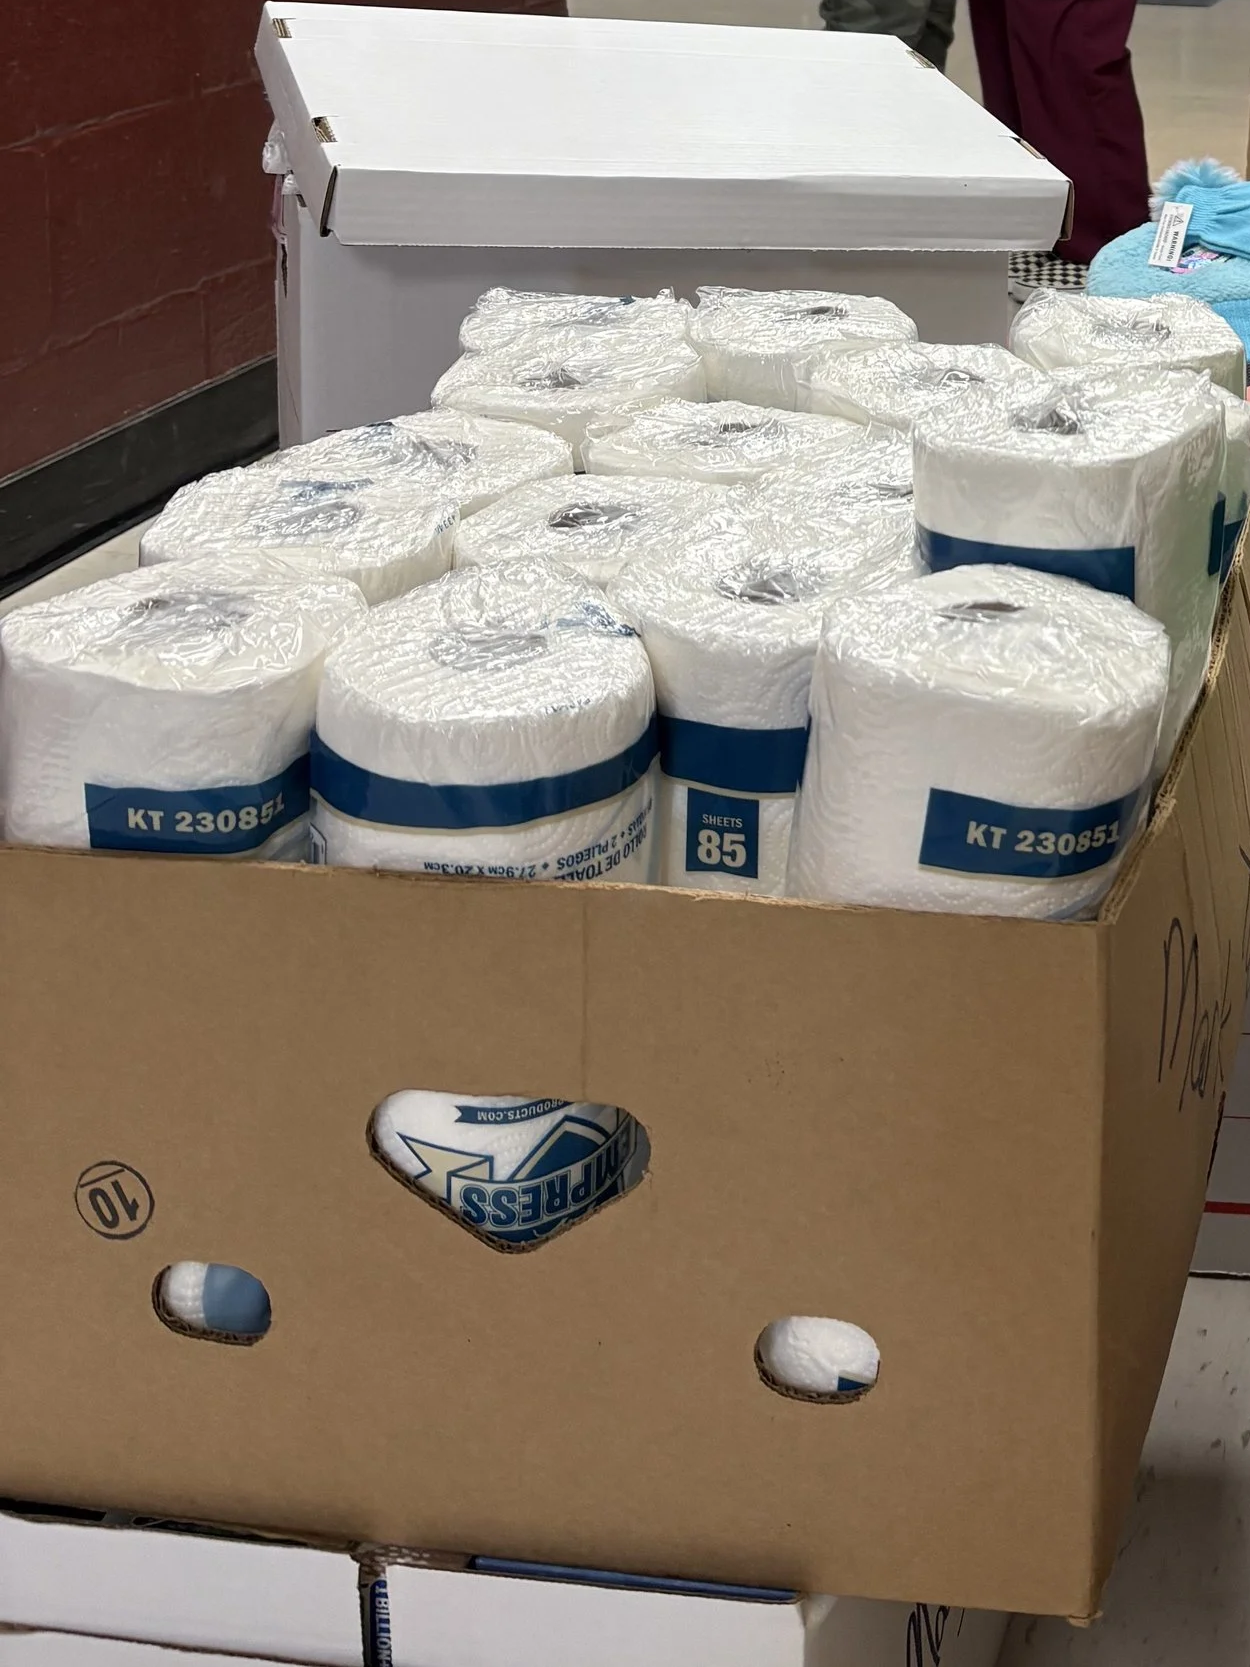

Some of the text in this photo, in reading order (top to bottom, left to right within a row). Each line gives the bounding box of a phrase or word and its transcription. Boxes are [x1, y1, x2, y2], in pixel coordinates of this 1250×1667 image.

[127, 791, 285, 833] KT 230851
[702, 813, 743, 829] SHEETS
[556, 839, 609, 870] PLIEGOS
[697, 830, 748, 868] 85
[966, 819, 1120, 856] KT 230851
[88, 1180, 140, 1230] 10
